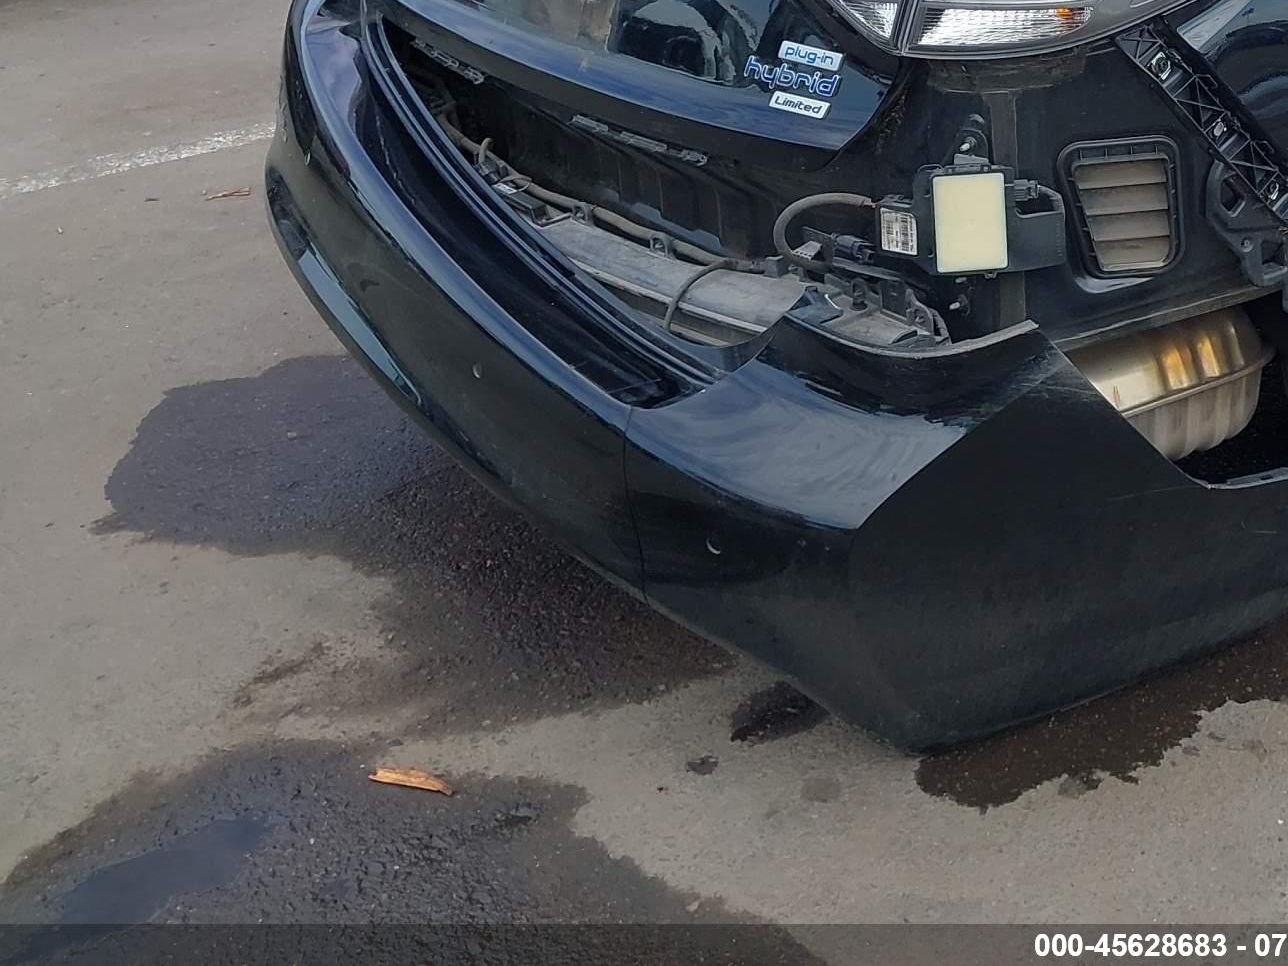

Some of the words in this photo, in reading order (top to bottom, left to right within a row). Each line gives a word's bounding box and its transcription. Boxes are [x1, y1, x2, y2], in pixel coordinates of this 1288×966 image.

[784, 46, 834, 65] plug-in
[743, 55, 840, 96] hybrid
[774, 95, 823, 114] Limited
